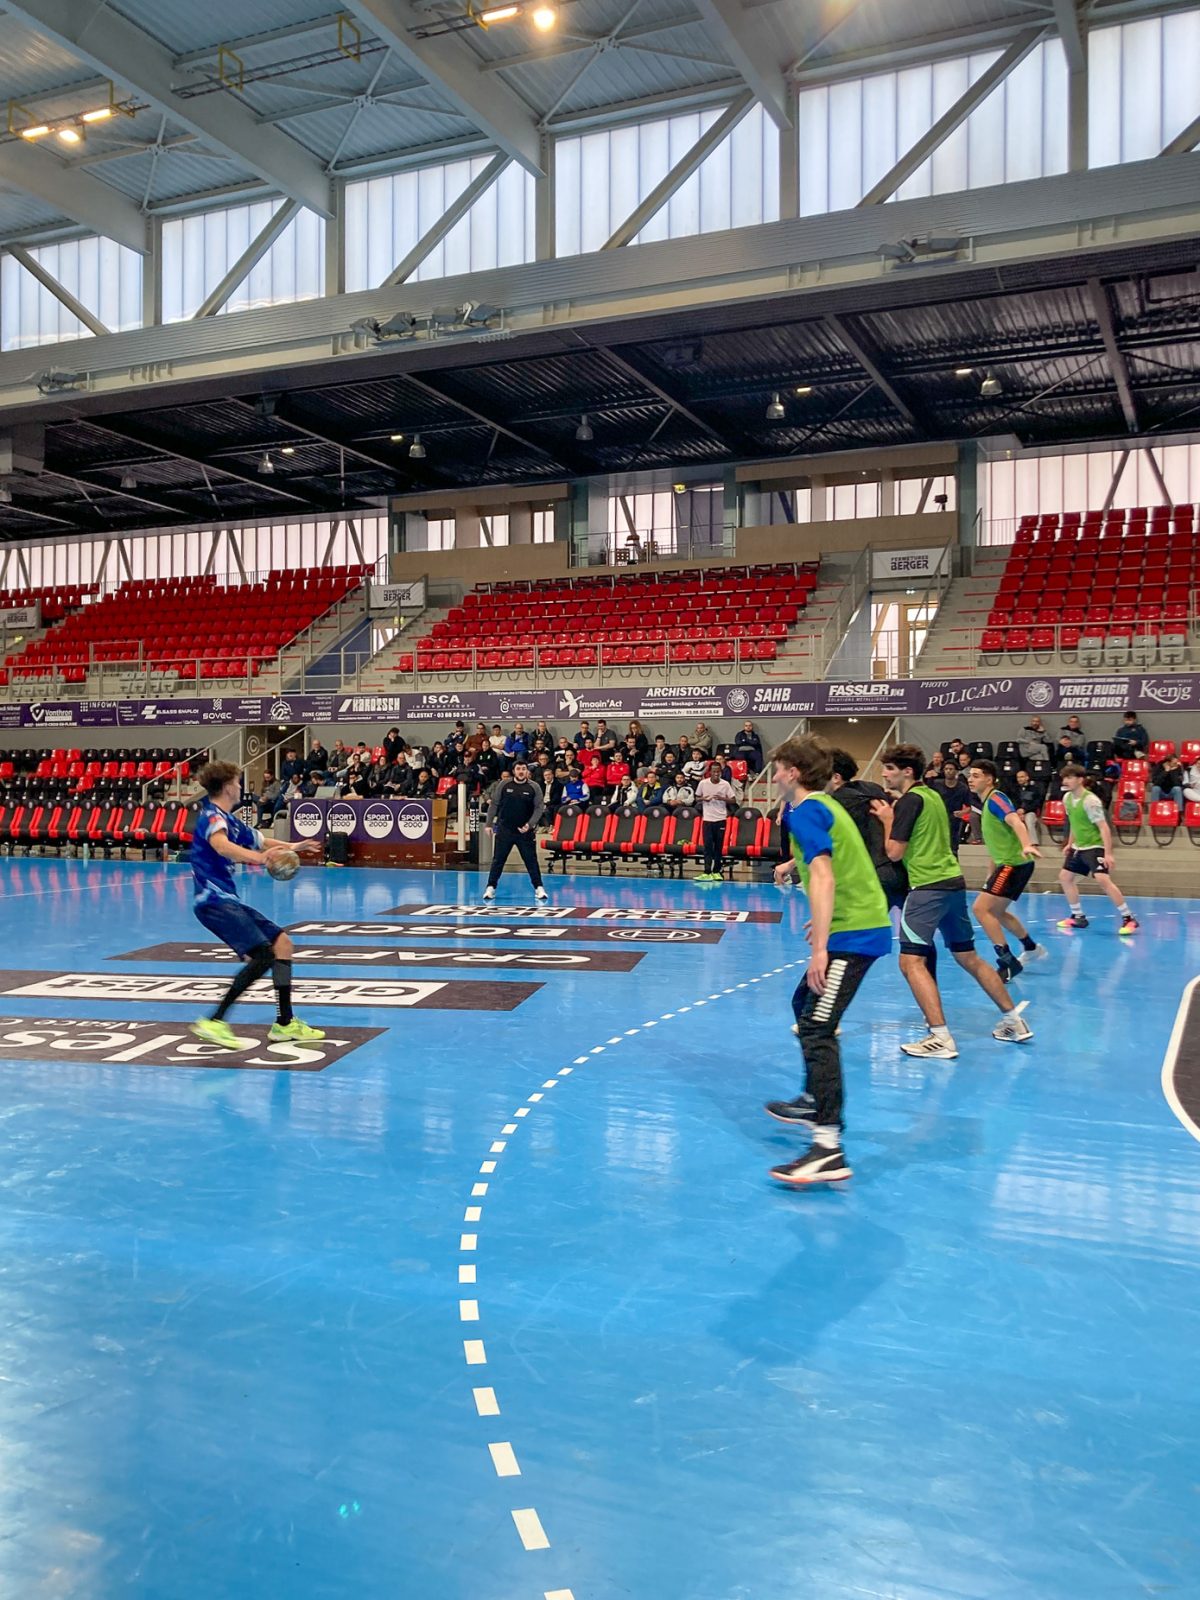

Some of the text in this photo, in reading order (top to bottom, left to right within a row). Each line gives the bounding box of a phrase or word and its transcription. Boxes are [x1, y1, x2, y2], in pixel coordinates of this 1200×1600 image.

[890, 560, 928, 570] BERGER
[646, 686, 716, 698] ARCHISTOCK
[754, 688, 792, 702] SAHB
[828, 684, 890, 696] FASSLER
[926, 679, 1012, 710] PULICANO
[1059, 684, 1129, 696] VENEZ RUGIR
[1138, 680, 1192, 704] Koenig
[422, 694, 460, 704] ISCA
[1059, 698, 1089, 708] AVEC
[1090, 697, 1122, 708] NOUS
[758, 704, 782, 712] QU'UN
[782, 703, 809, 712] MATCH
[288, 924, 568, 938] BOSCH
[291, 950, 592, 964] CRAFT
[34, 1020, 157, 1030] Alsace
